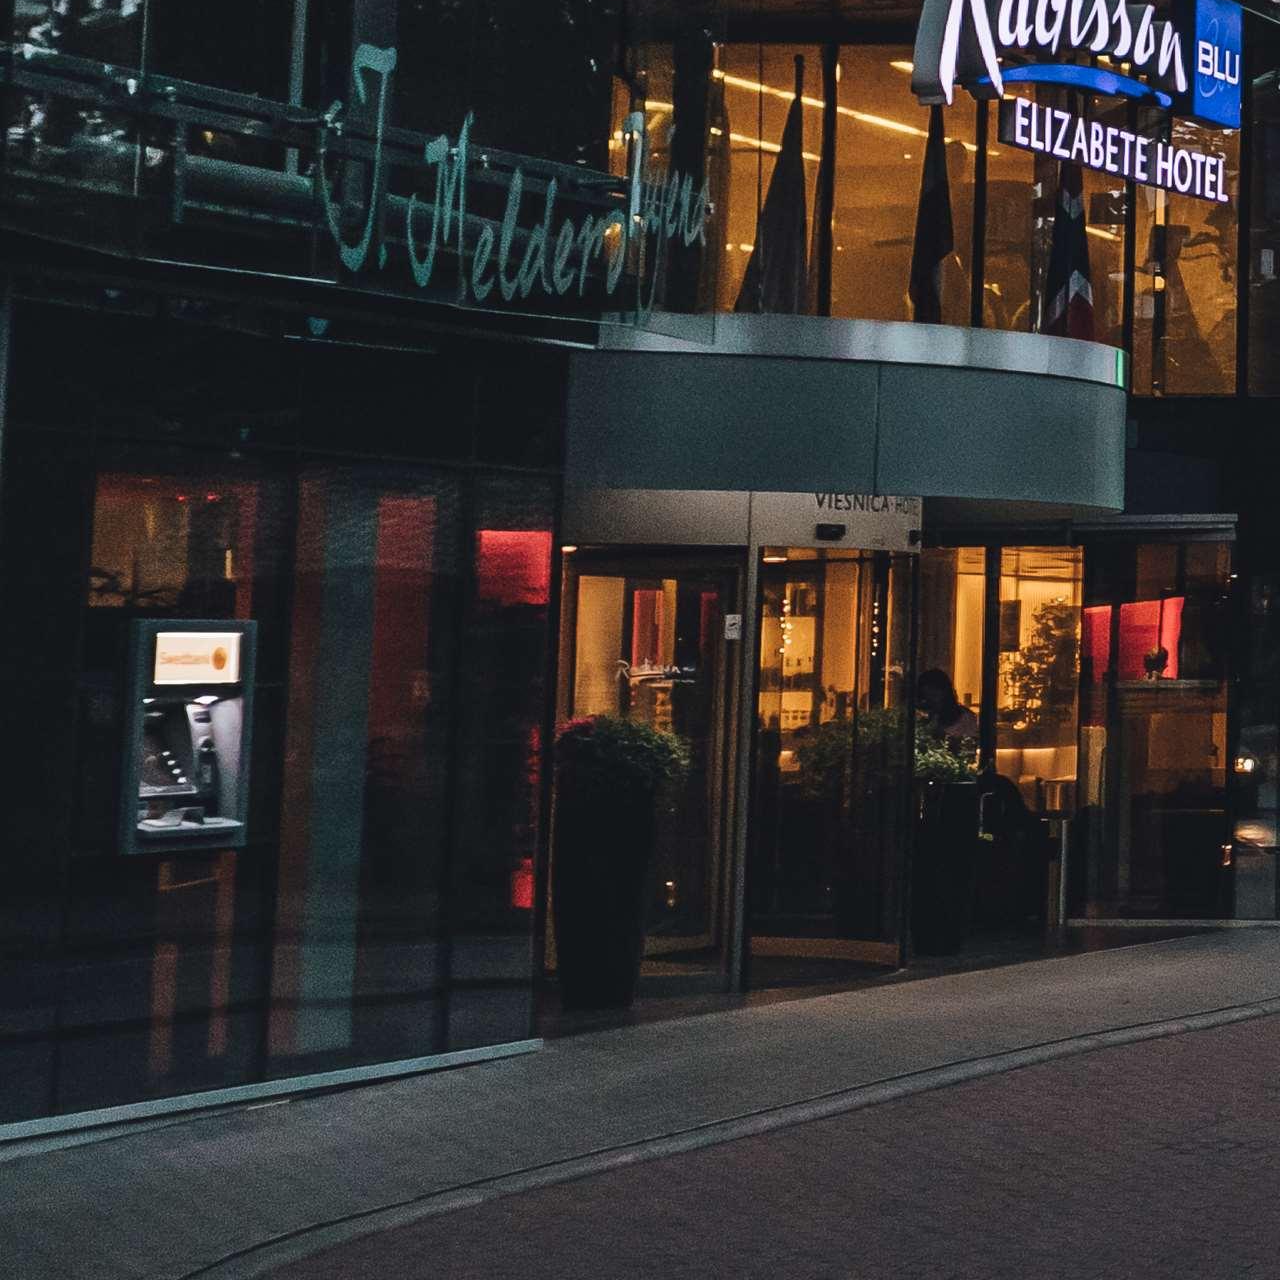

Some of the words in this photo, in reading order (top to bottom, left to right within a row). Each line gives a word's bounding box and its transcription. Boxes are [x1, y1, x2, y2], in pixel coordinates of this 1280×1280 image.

[1197, 41, 1240, 84] BLU
[1015, 98, 1148, 181] ELIZABETE
[1157, 148, 1229, 202] HOTEL
